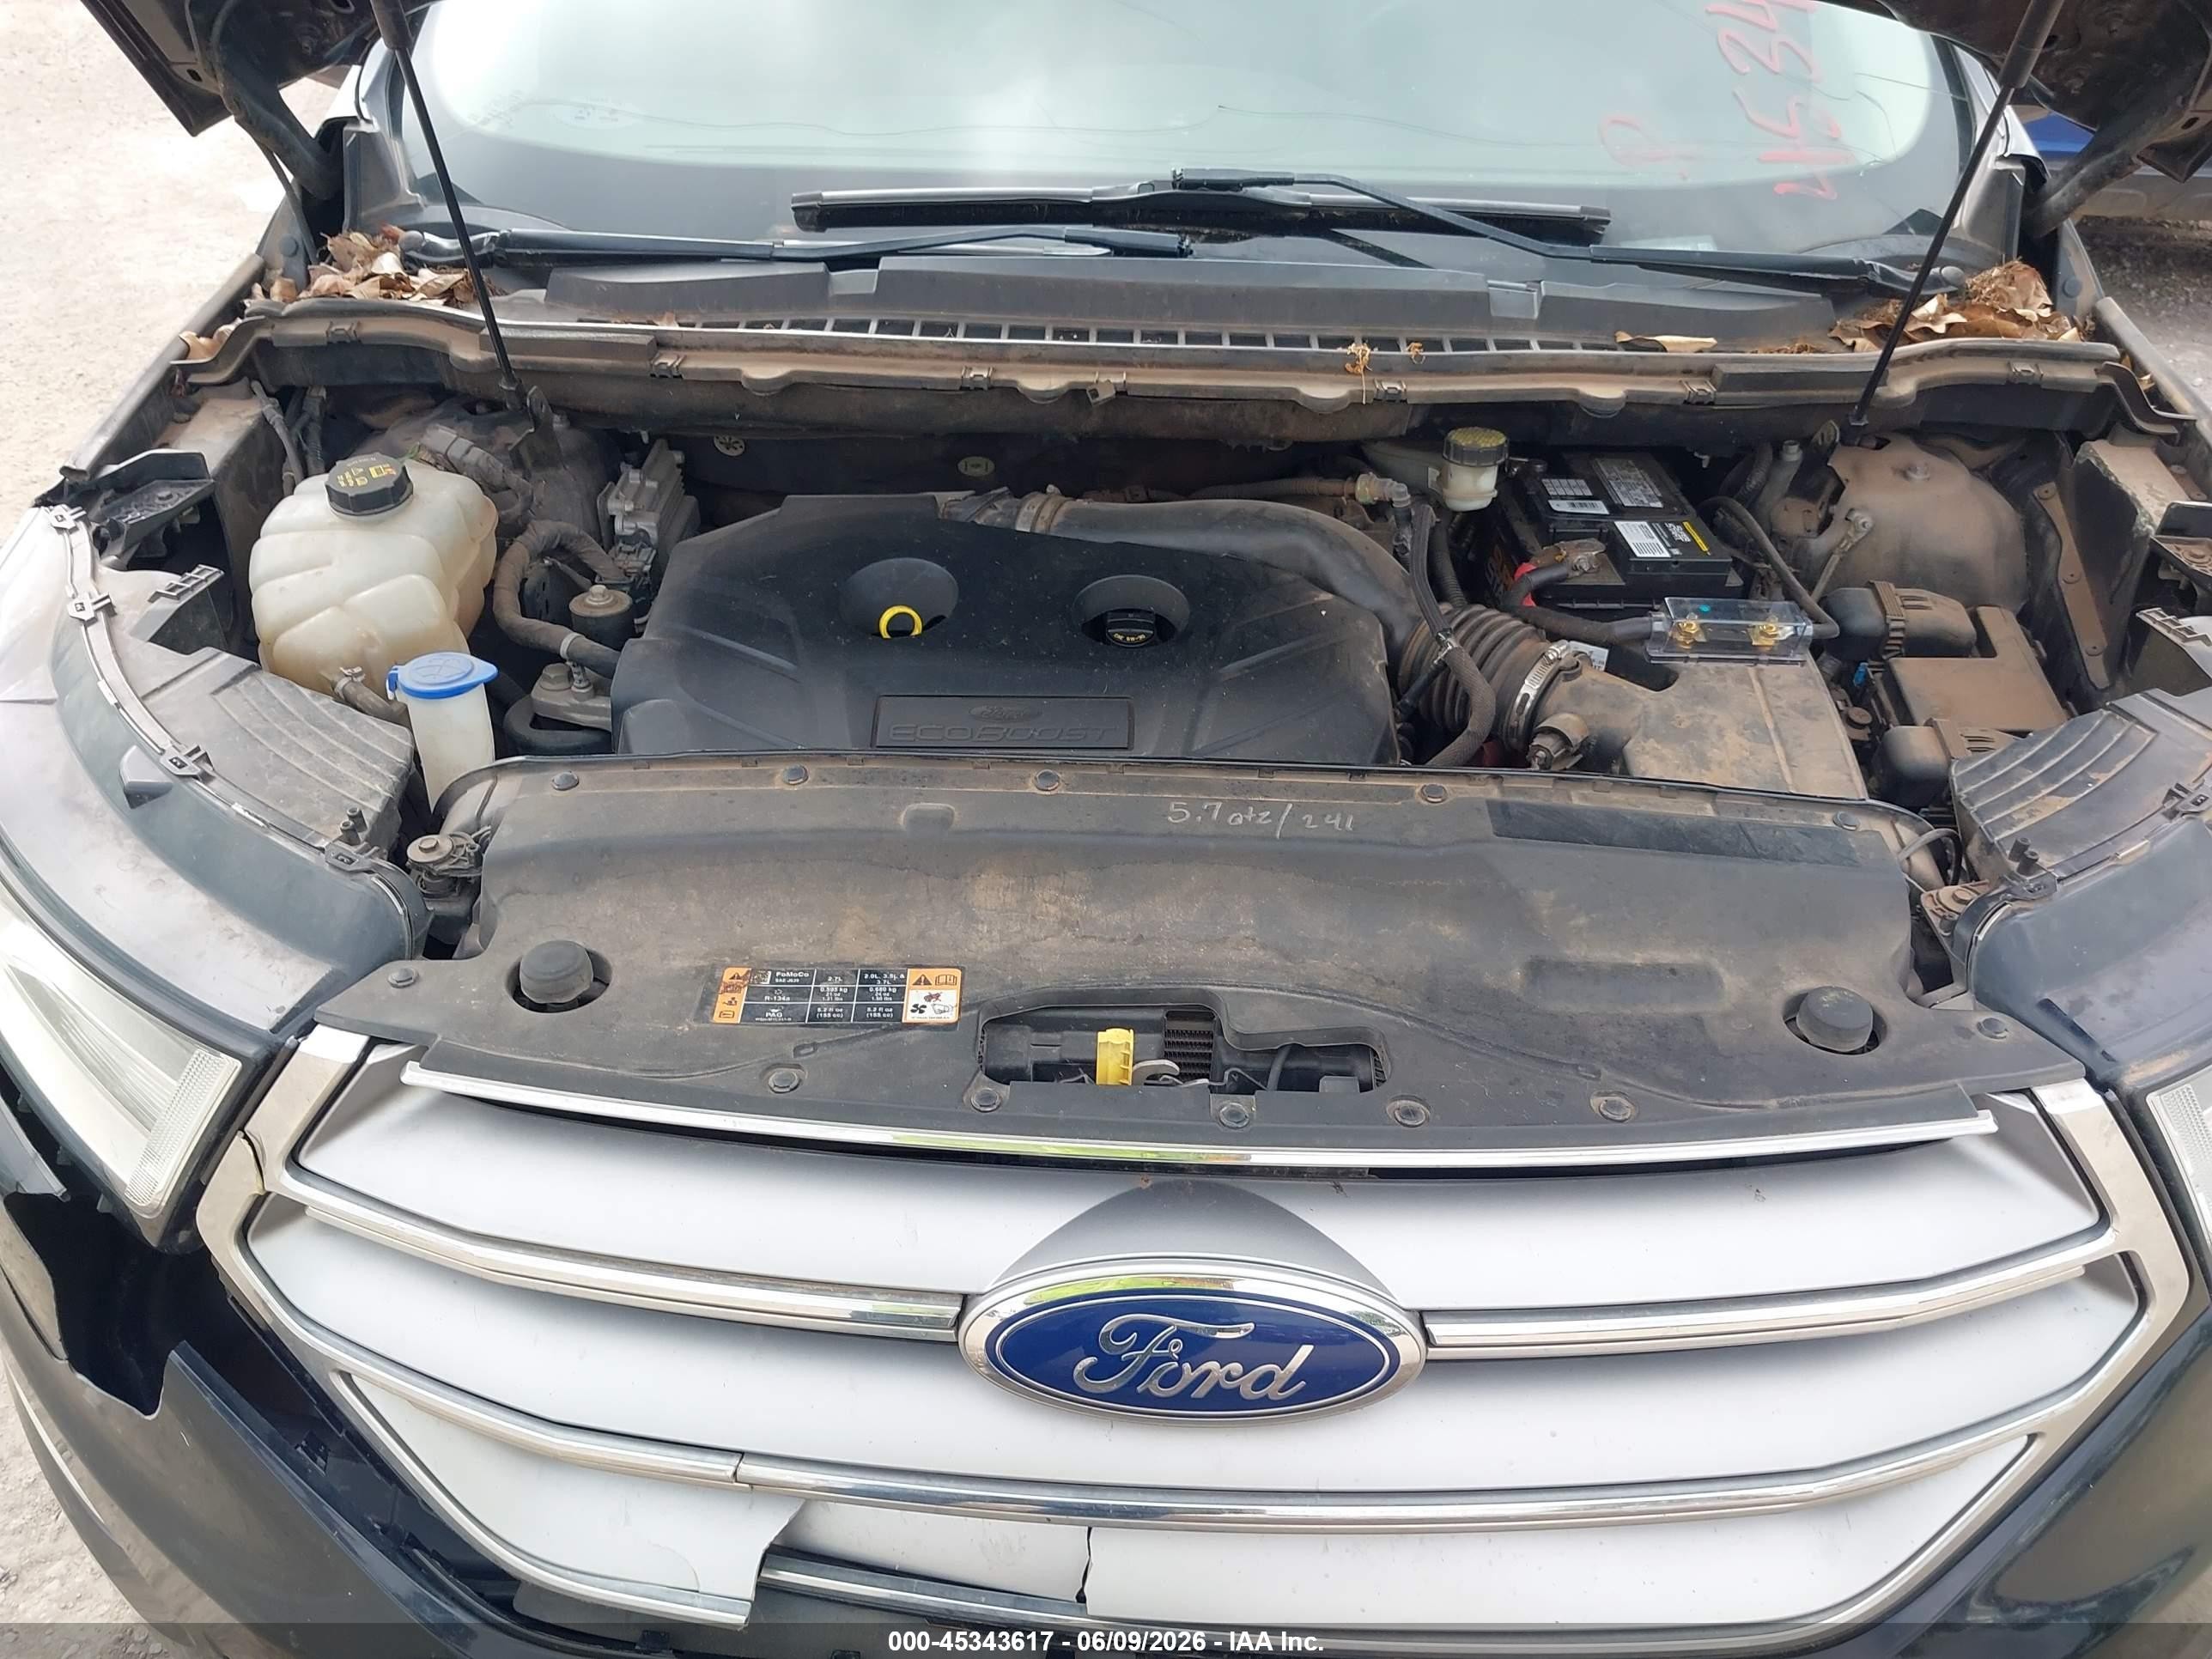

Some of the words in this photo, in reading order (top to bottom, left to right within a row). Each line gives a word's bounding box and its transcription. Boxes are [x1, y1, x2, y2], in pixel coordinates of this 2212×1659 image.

[889, 723, 1116, 743] ECOBOOST
[1167, 801, 1223, 823] 5.7
[1073, 1313, 1314, 1401] Ford
